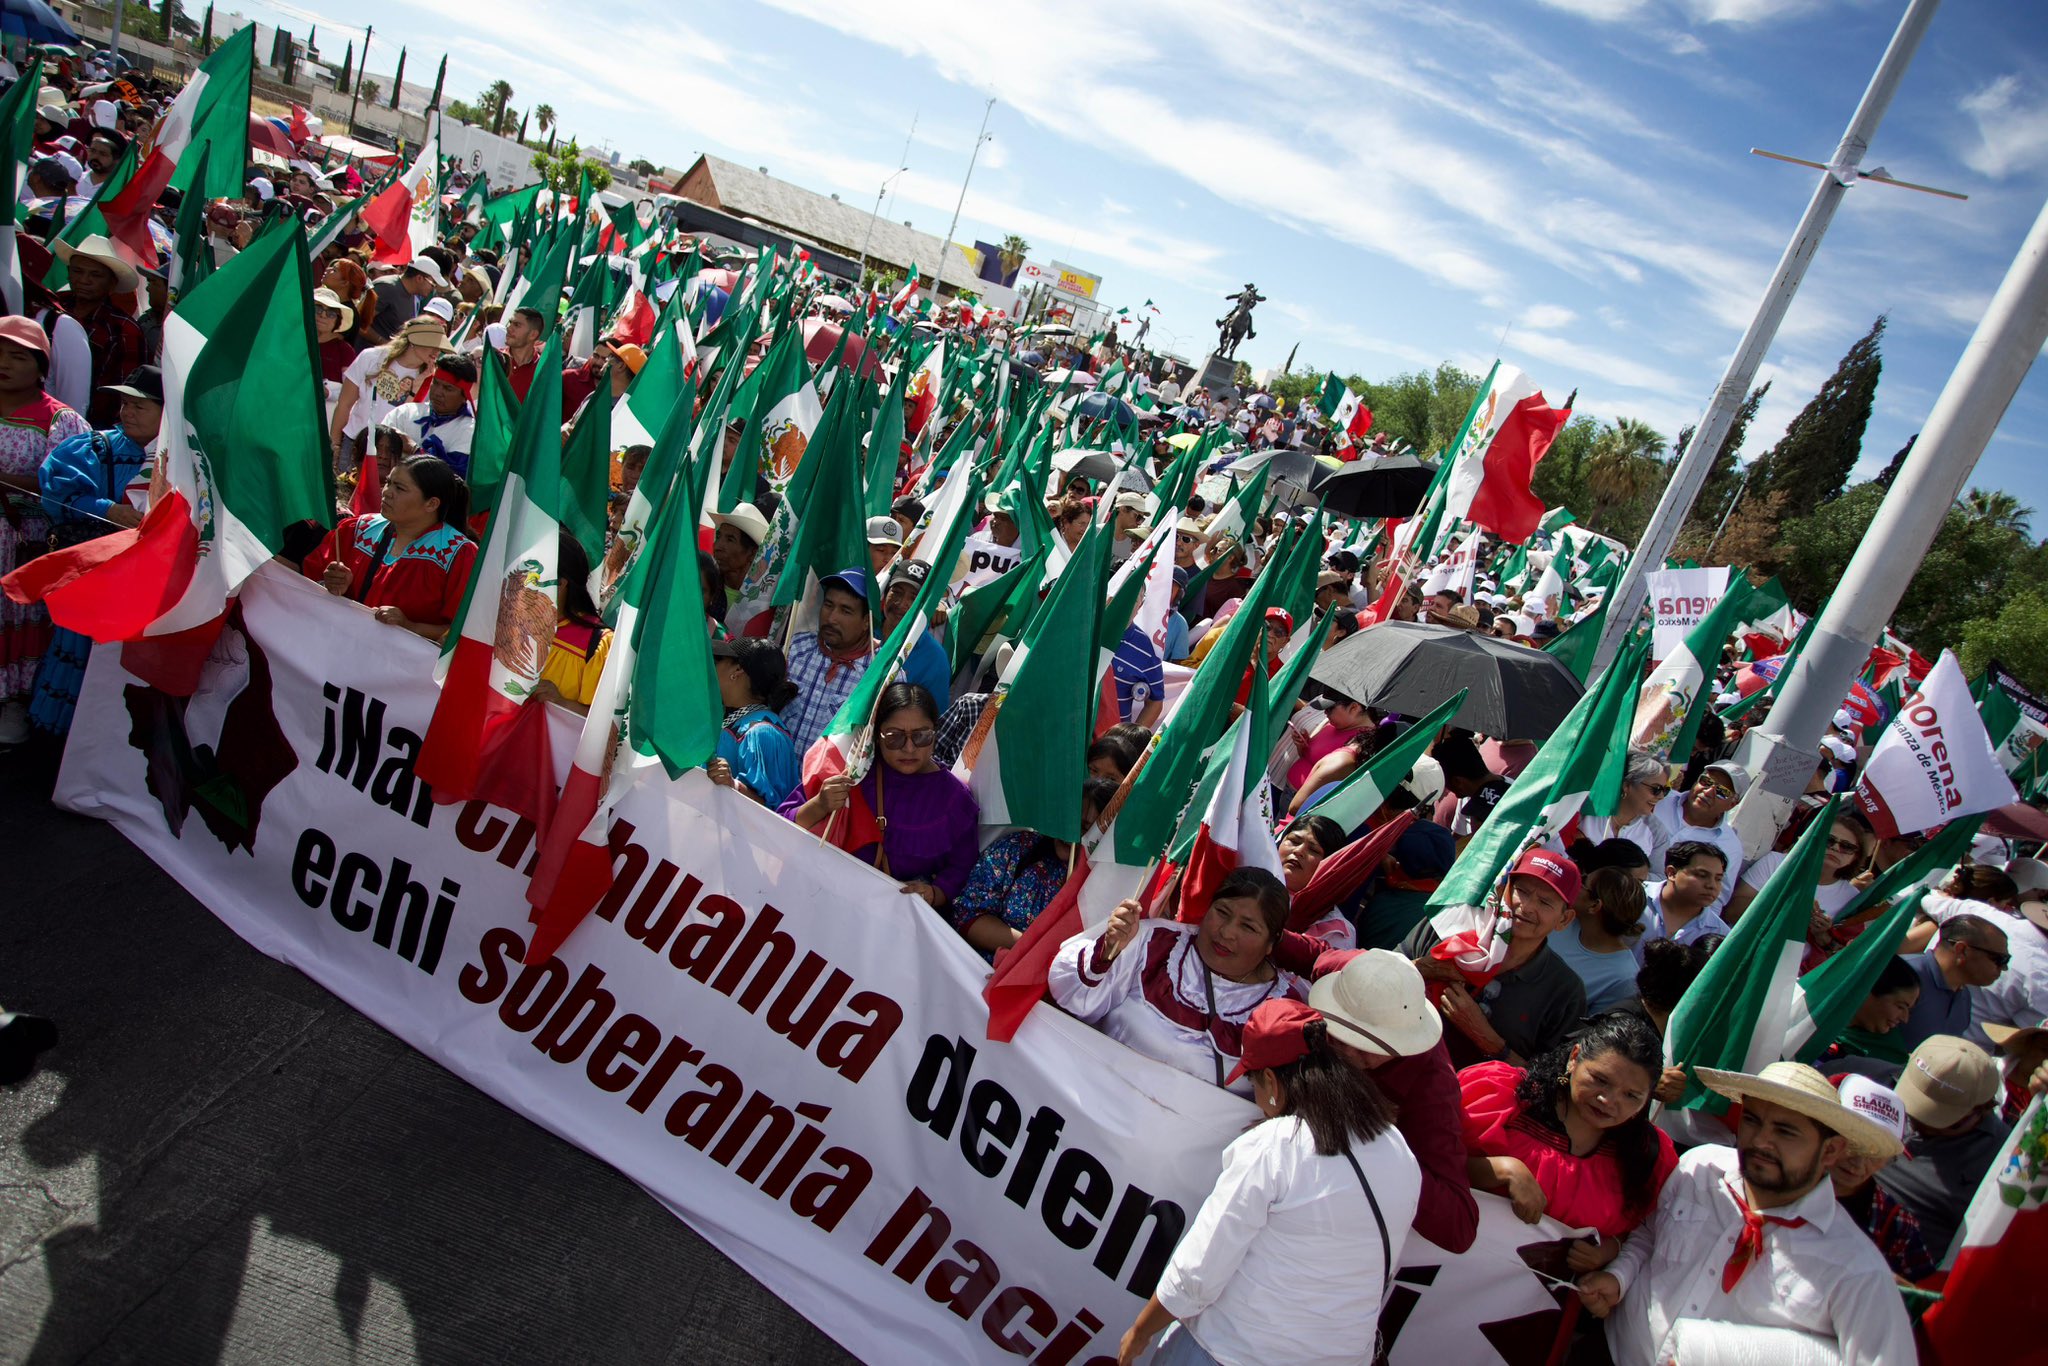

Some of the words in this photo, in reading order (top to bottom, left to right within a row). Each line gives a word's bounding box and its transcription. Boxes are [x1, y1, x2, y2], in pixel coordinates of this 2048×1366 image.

[473, 154, 480, 166] E
[1480, 787, 1500, 805] NY
[1857, 779, 1879, 813] na.org
[1916, 753, 1932, 768] de
[1927, 770, 1946, 815] México
[1531, 856, 1563, 875] morena
[291, 828, 461, 976] echi
[458, 926, 873, 1233] soberanía
[864, 1187, 1121, 1366] naci
[1853, 1095, 1899, 1117] CLAUDIA
[906, 1033, 1187, 1301] defen
